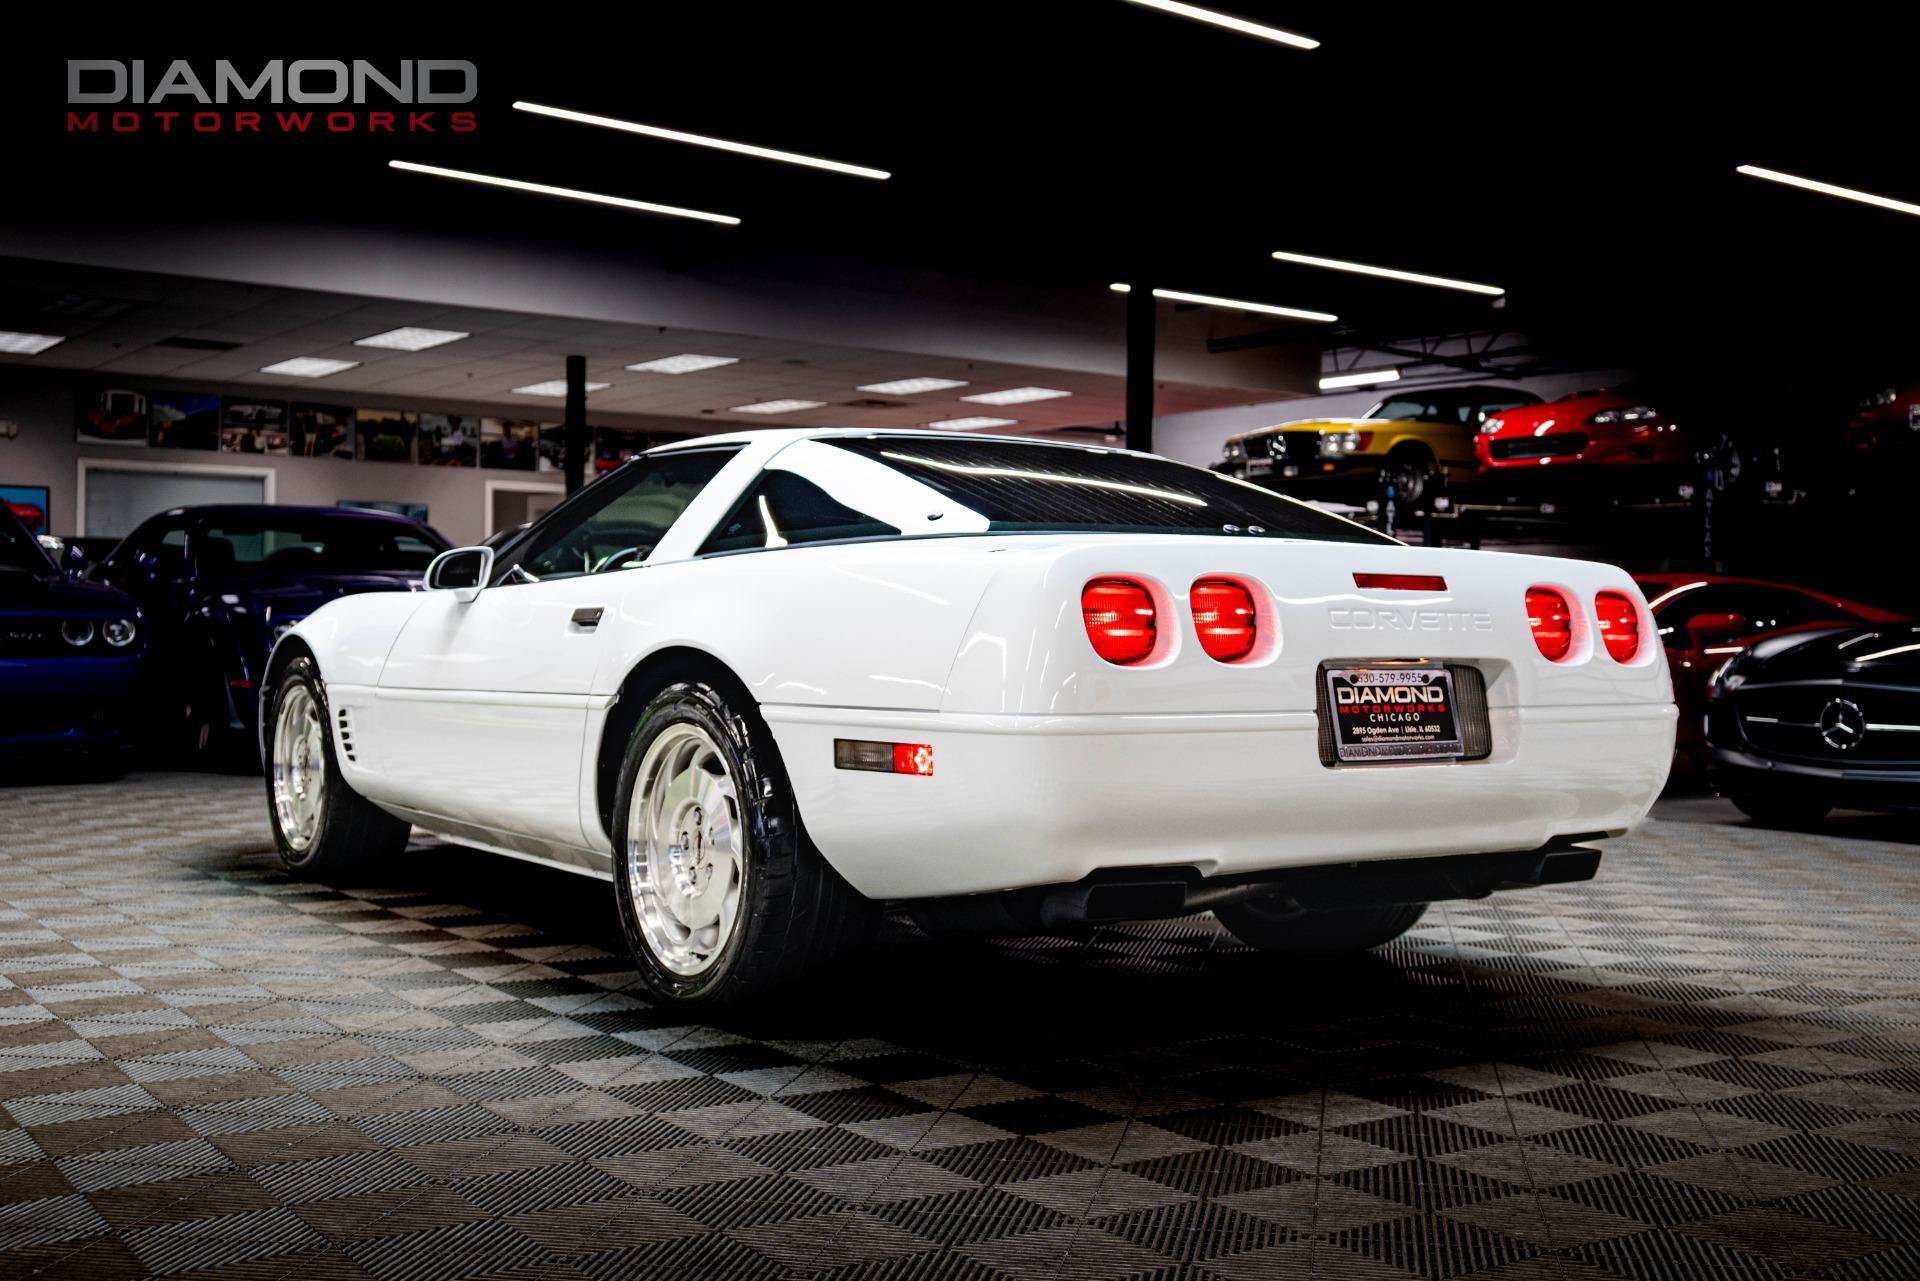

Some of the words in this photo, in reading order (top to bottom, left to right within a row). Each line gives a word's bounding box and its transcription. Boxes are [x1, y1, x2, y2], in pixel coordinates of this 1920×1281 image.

[1328, 608, 1493, 631] CORVETTE
[1336, 686, 1444, 704] DIAMOND
[1339, 704, 1446, 714] MOTORWORKS
[1369, 712, 1420, 722] CHICAGO
[1366, 726, 1387, 735] Ogden
